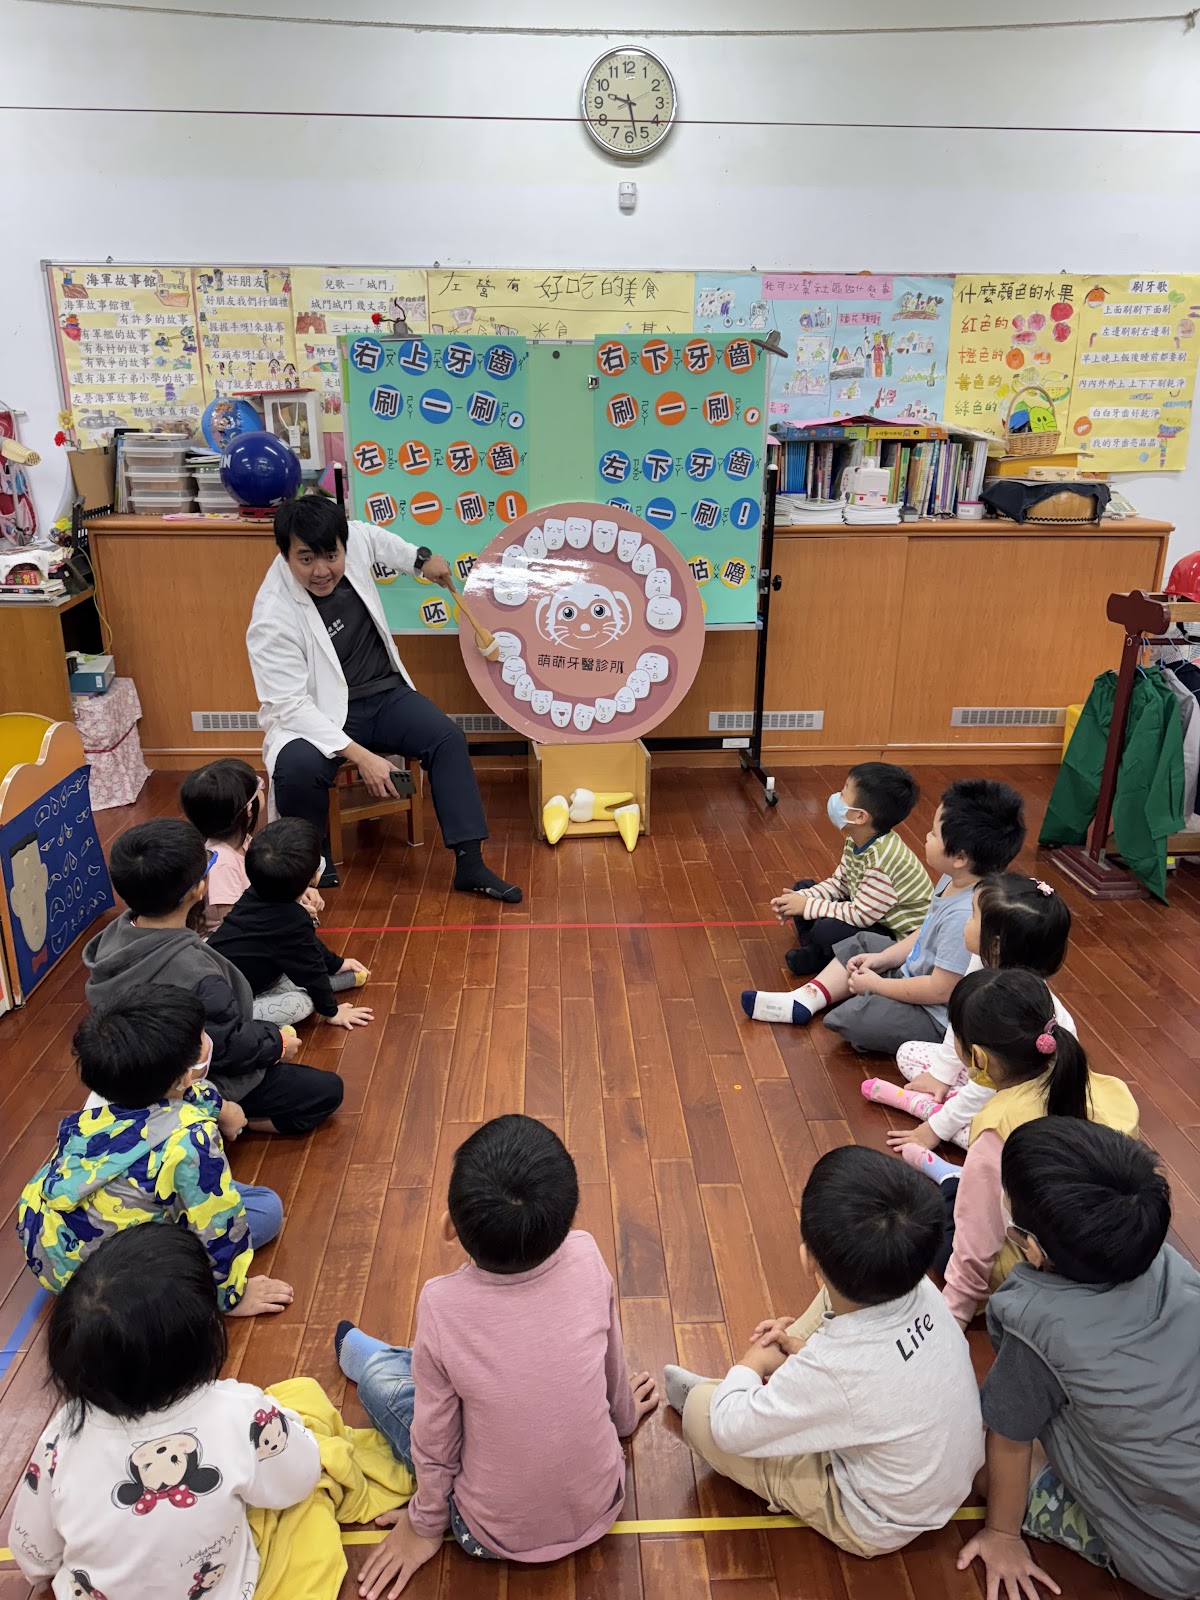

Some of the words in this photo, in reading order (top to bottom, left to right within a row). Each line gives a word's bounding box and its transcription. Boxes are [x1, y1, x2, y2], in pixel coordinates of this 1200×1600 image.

[608, 66, 618, 78] 11
[622, 61, 635, 73] 12
[642, 66, 647, 79] 1
[596, 79, 610, 91] 10
[651, 79, 660, 91] 2
[594, 96, 604, 109] 9
[655, 97, 664, 109] 3
[598, 114, 607, 126] 8
[651, 114, 660, 126] 4
[611, 127, 619, 138] 7
[625, 131, 634, 144] 6
[640, 127, 649, 138] 5
[86, 274, 156, 287] 海軍故事館
[227, 276, 265, 288] 好朋友
[957, 281, 1074, 304] 什麼顏色的水果
[1131, 281, 1168, 293] 刷牙歌
[64, 300, 131, 311] 海軍故事館裡
[205, 296, 288, 308] 好朋友我們行個禮
[1103, 305, 1170, 315] 上面刷刷下面刷
[120, 314, 188, 326] 有許多的故事
[961, 313, 1008, 333] 紅色的
[82, 329, 149, 340] 有軍艦的故事
[1102, 326, 1170, 336] 左邊刷刷右邊刷
[958, 346, 1004, 365] 橙色的
[955, 374, 1002, 391] 黃色的
[73, 392, 149, 404] 左營海軍故事館
[955, 400, 997, 416] 綠色的
[537, 654, 626, 674] 萌萌牙醫診所
[896, 1314, 934, 1362] Life
